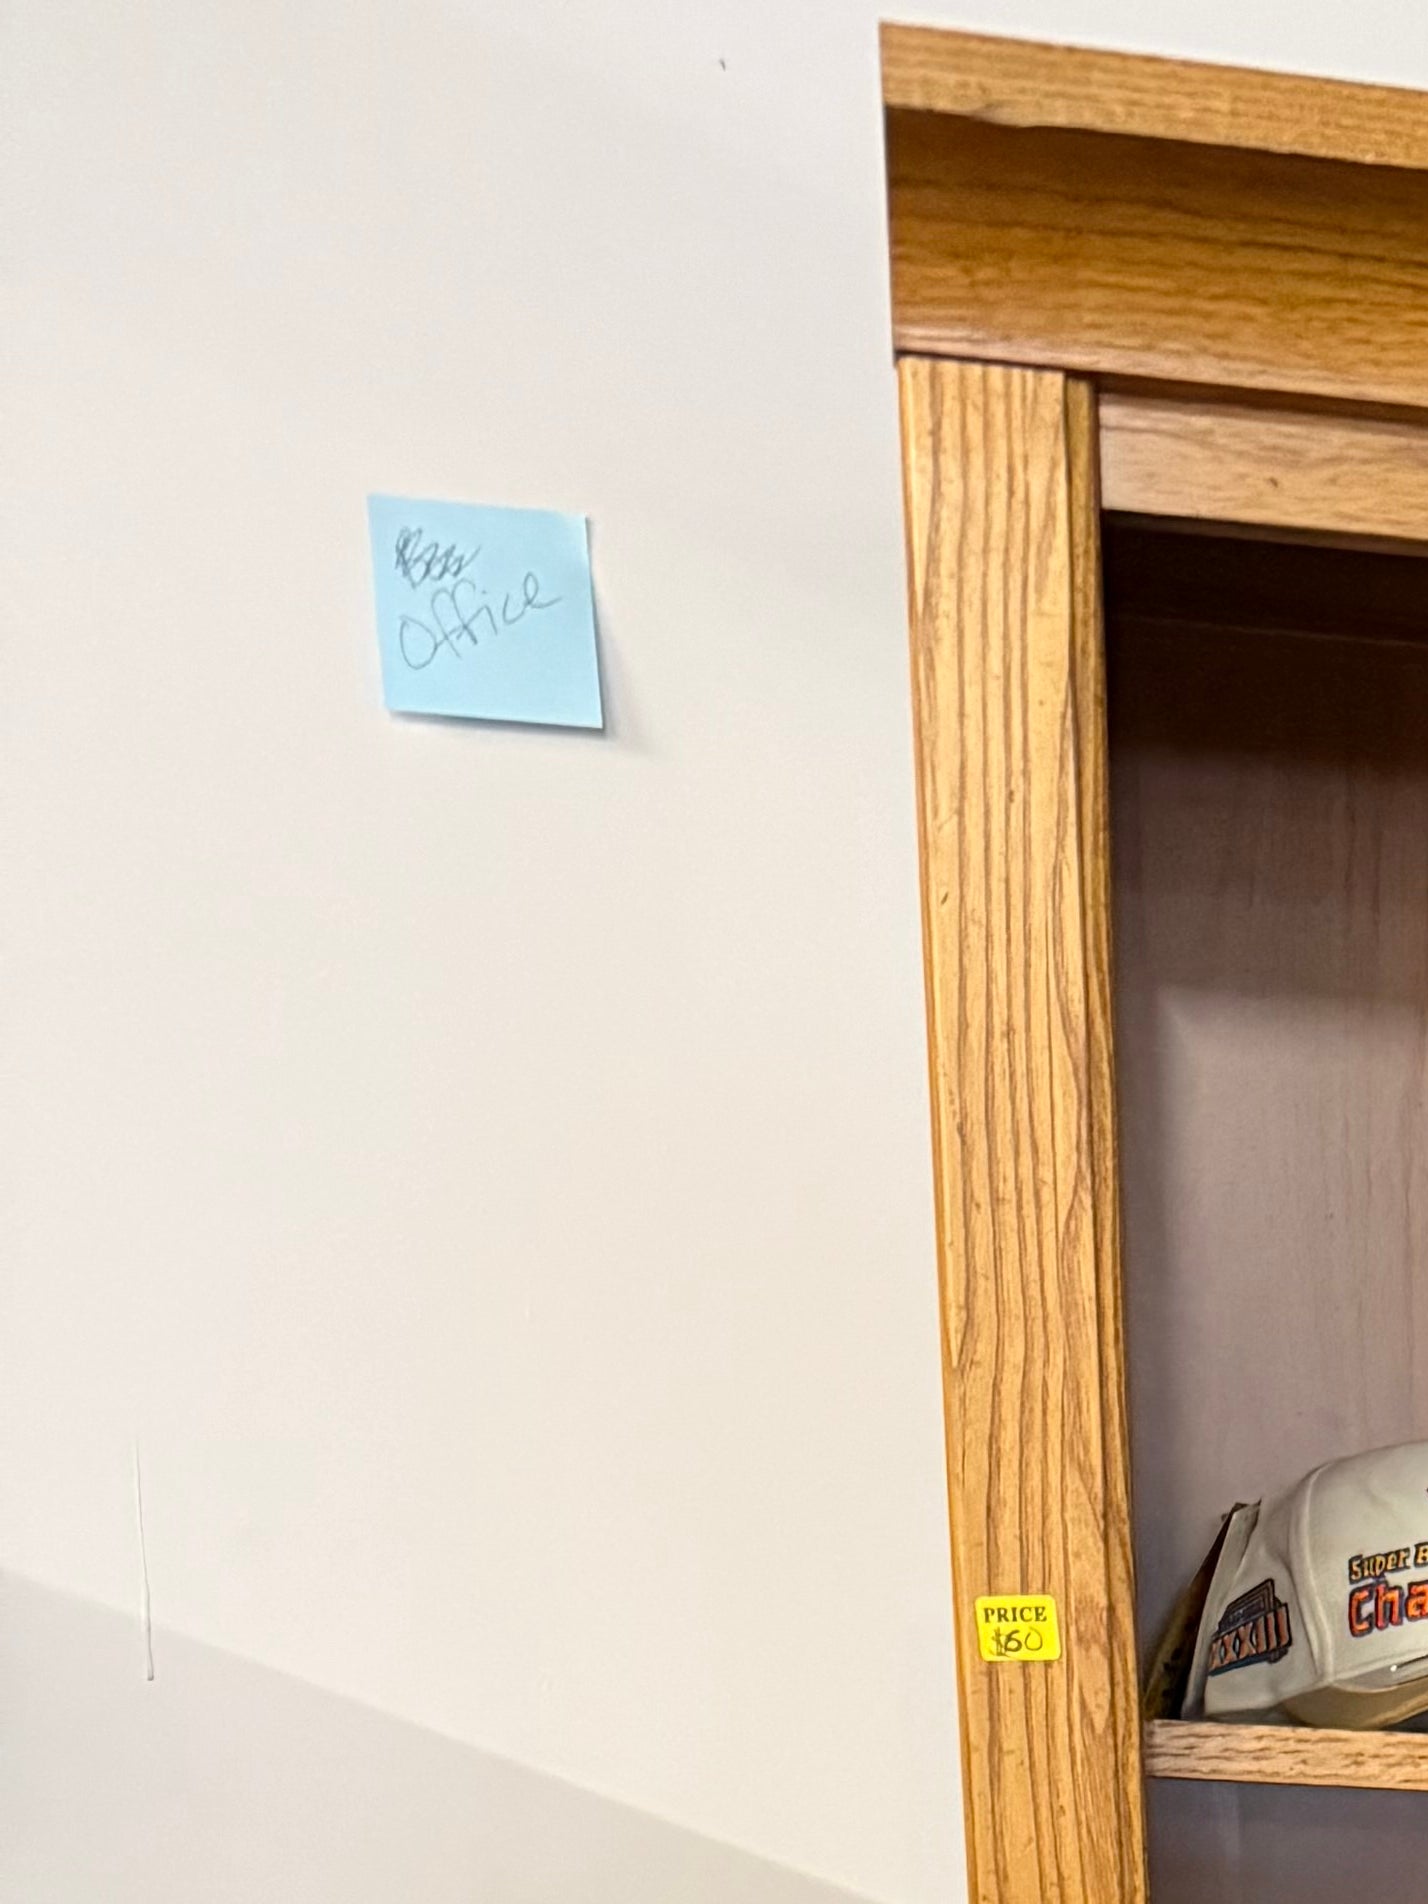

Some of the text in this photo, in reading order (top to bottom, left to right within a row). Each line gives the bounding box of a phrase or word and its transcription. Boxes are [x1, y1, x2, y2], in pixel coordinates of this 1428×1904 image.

[400, 571, 562, 670] Office
[1349, 1550, 1410, 1584] Super
[983, 1605, 1048, 1624] PRICE
